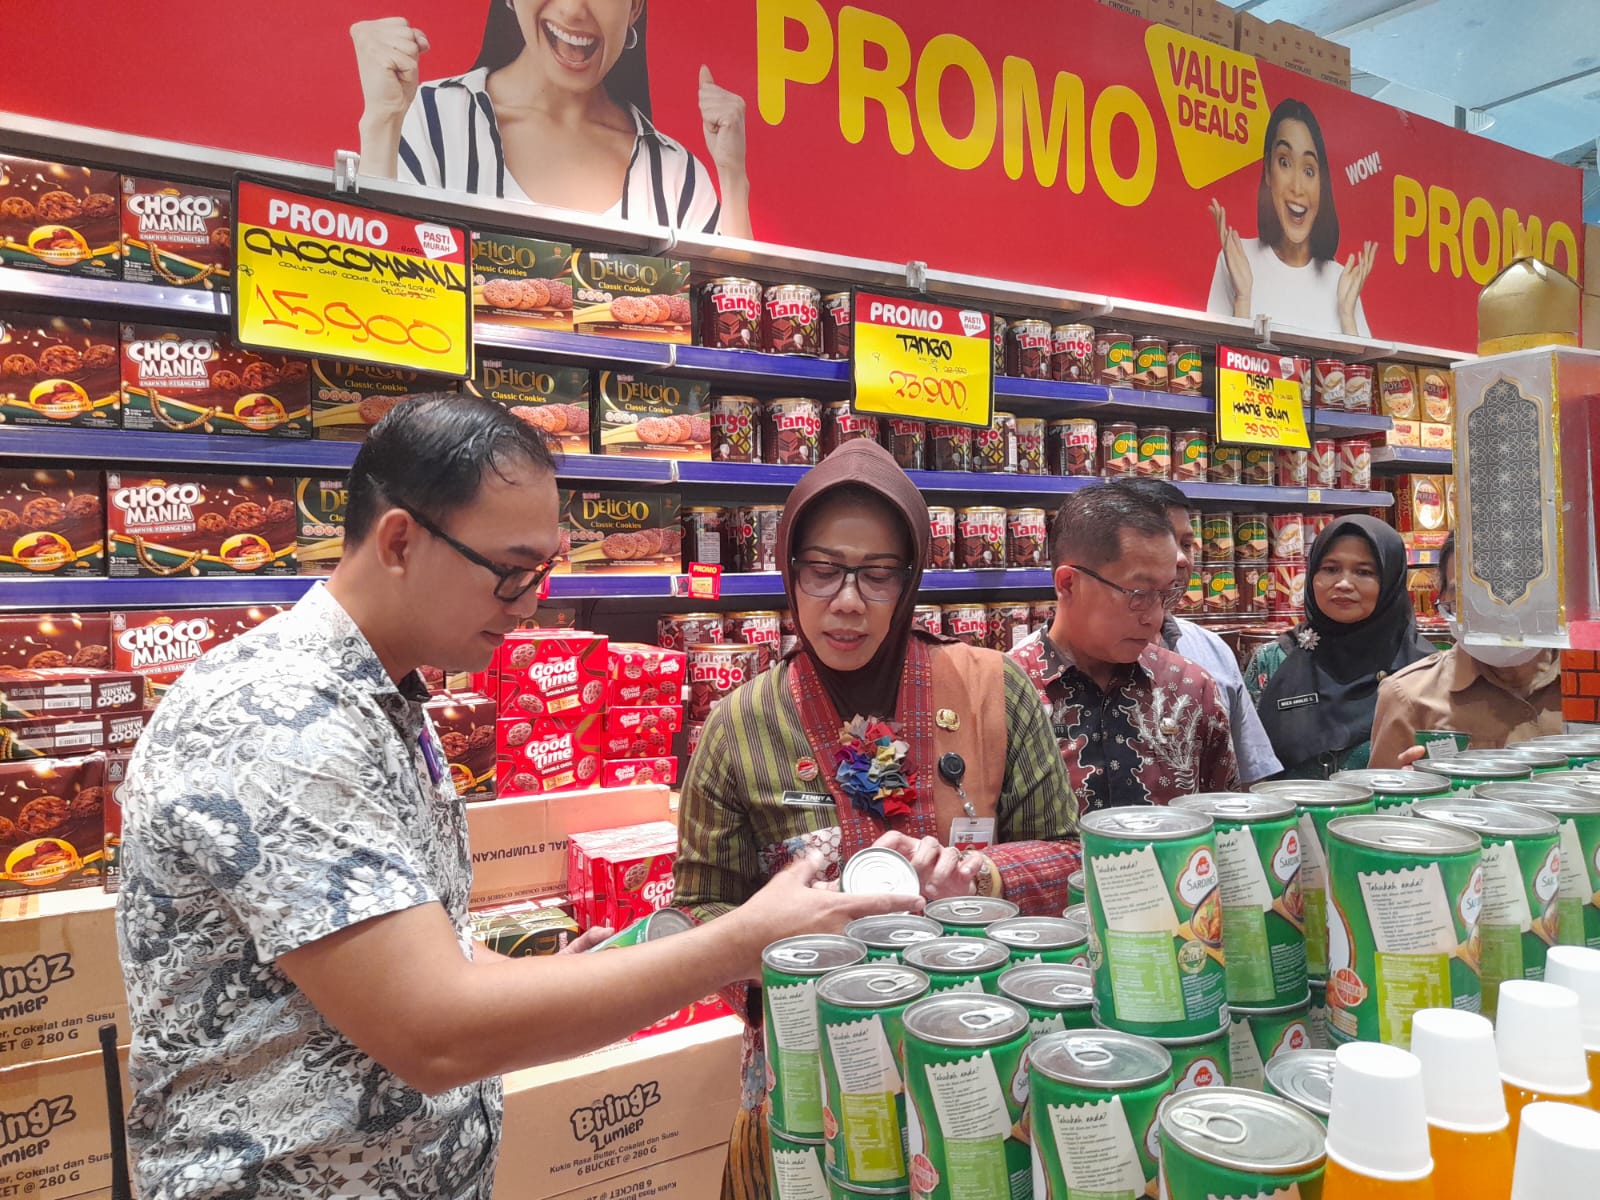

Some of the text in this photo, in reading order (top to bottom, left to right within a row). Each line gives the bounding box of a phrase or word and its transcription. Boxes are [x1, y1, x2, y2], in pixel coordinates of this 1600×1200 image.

[1167, 42, 1258, 110] VALUE
[757, 0, 1157, 207] PROMO
[1178, 96, 1249, 145] DEALS
[1345, 152, 1383, 186] WOW!
[128, 194, 213, 217] CHOCO
[140, 213, 207, 233] MANIA
[269, 199, 389, 246] PROMO
[1393, 174, 1578, 285] PROMO
[423, 231, 450, 244] PASTI
[423, 241, 450, 253] MURAH
[598, 281, 651, 294] Classic Cookies
[711, 293, 761, 321] Tango
[766, 300, 818, 326] Tango
[870, 301, 943, 330] PROMO
[128, 340, 213, 361] CHOCO
[896, 333, 952, 361] TANGO
[140, 359, 207, 378] MANIA
[1227, 351, 1270, 374] PROMO
[344, 379, 408, 392] Classic Cookies
[491, 391, 547, 403] Classic Cookies
[625, 403, 673, 414] Classic Cookies
[773, 413, 822, 437] Tango
[113, 484, 199, 509] CHOCO
[126, 503, 193, 525] MANIA
[590, 521, 642, 530] Classic Cookies
[1009, 521, 1047, 543] Tang
[119, 620, 208, 650] CHOCO
[132, 640, 201, 667] MANIA
[529, 656, 578, 680] Good
[689, 662, 743, 690] Tango
[537, 671, 578, 693] Time
[108, 727, 143, 744] HOCO
[525, 733, 572, 758] Good
[533, 748, 573, 770] Time
[472, 843, 545, 863] 8 TUMPUKAN
[643, 880, 675, 900] Goo
[13, 1020, 58, 1036] Cokelat
[61, 1017, 83, 1028] dan
[86, 1012, 115, 1023] Susu
[37, 1031, 64, 1046] 280
[68, 1028, 79, 1039] G
[570, 1081, 662, 1141] Bringz
[590, 1117, 644, 1152] Lumier
[550, 1162, 572, 1174] Kukis
[573, 1156, 592, 1167] Rasa
[618, 1140, 646, 1153] Cokelat
[646, 1136, 660, 1145] dan
[661, 1130, 679, 1141] Susu
[577, 1166, 584, 1176] 6
[585, 1156, 621, 1175] BUCKET
[632, 1147, 649, 1160] 280
[650, 1144, 658, 1154] G
[16, 1151, 113, 1181] Cokelat dan Sus
[39, 1175, 66, 1190] 280
[69, 1170, 80, 1182] G
[610, 1181, 646, 1199] BUCKET
